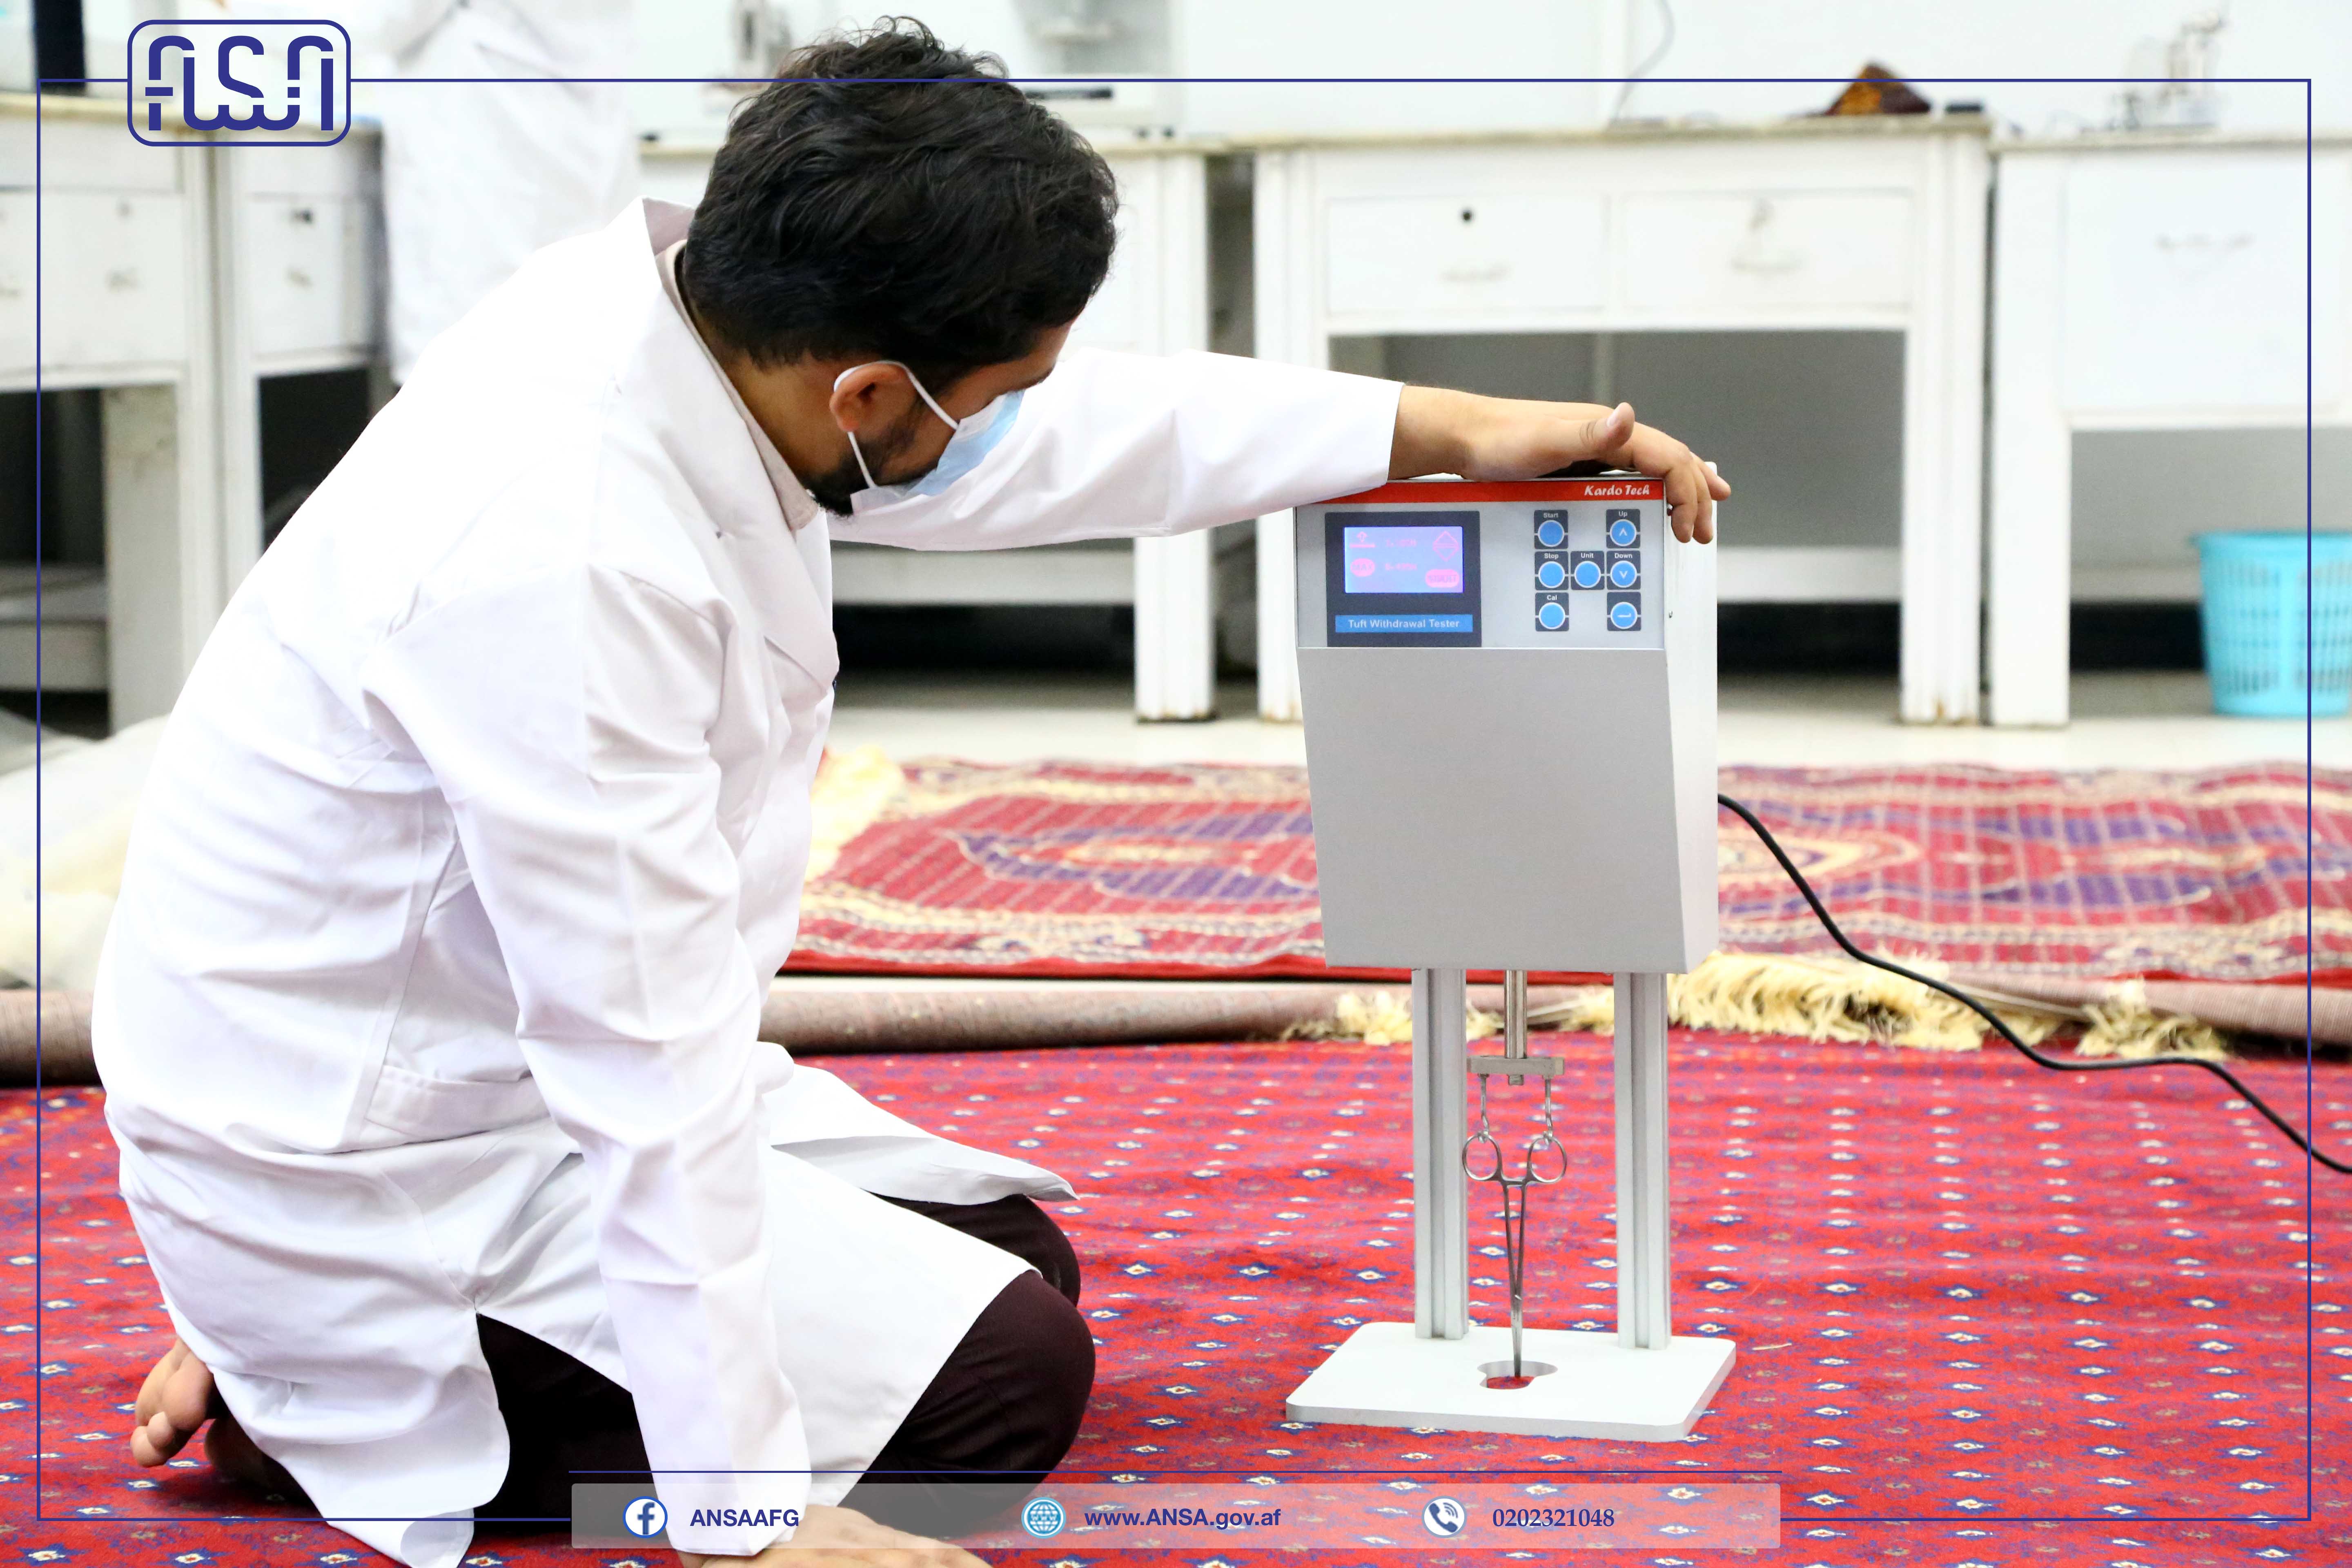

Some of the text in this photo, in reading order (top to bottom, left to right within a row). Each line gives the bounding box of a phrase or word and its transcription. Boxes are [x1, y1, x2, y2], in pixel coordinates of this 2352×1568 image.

[1584, 485, 1650, 496] Kardo Tech
[1349, 619, 1459, 628] Tuft Withdrawal Tester
